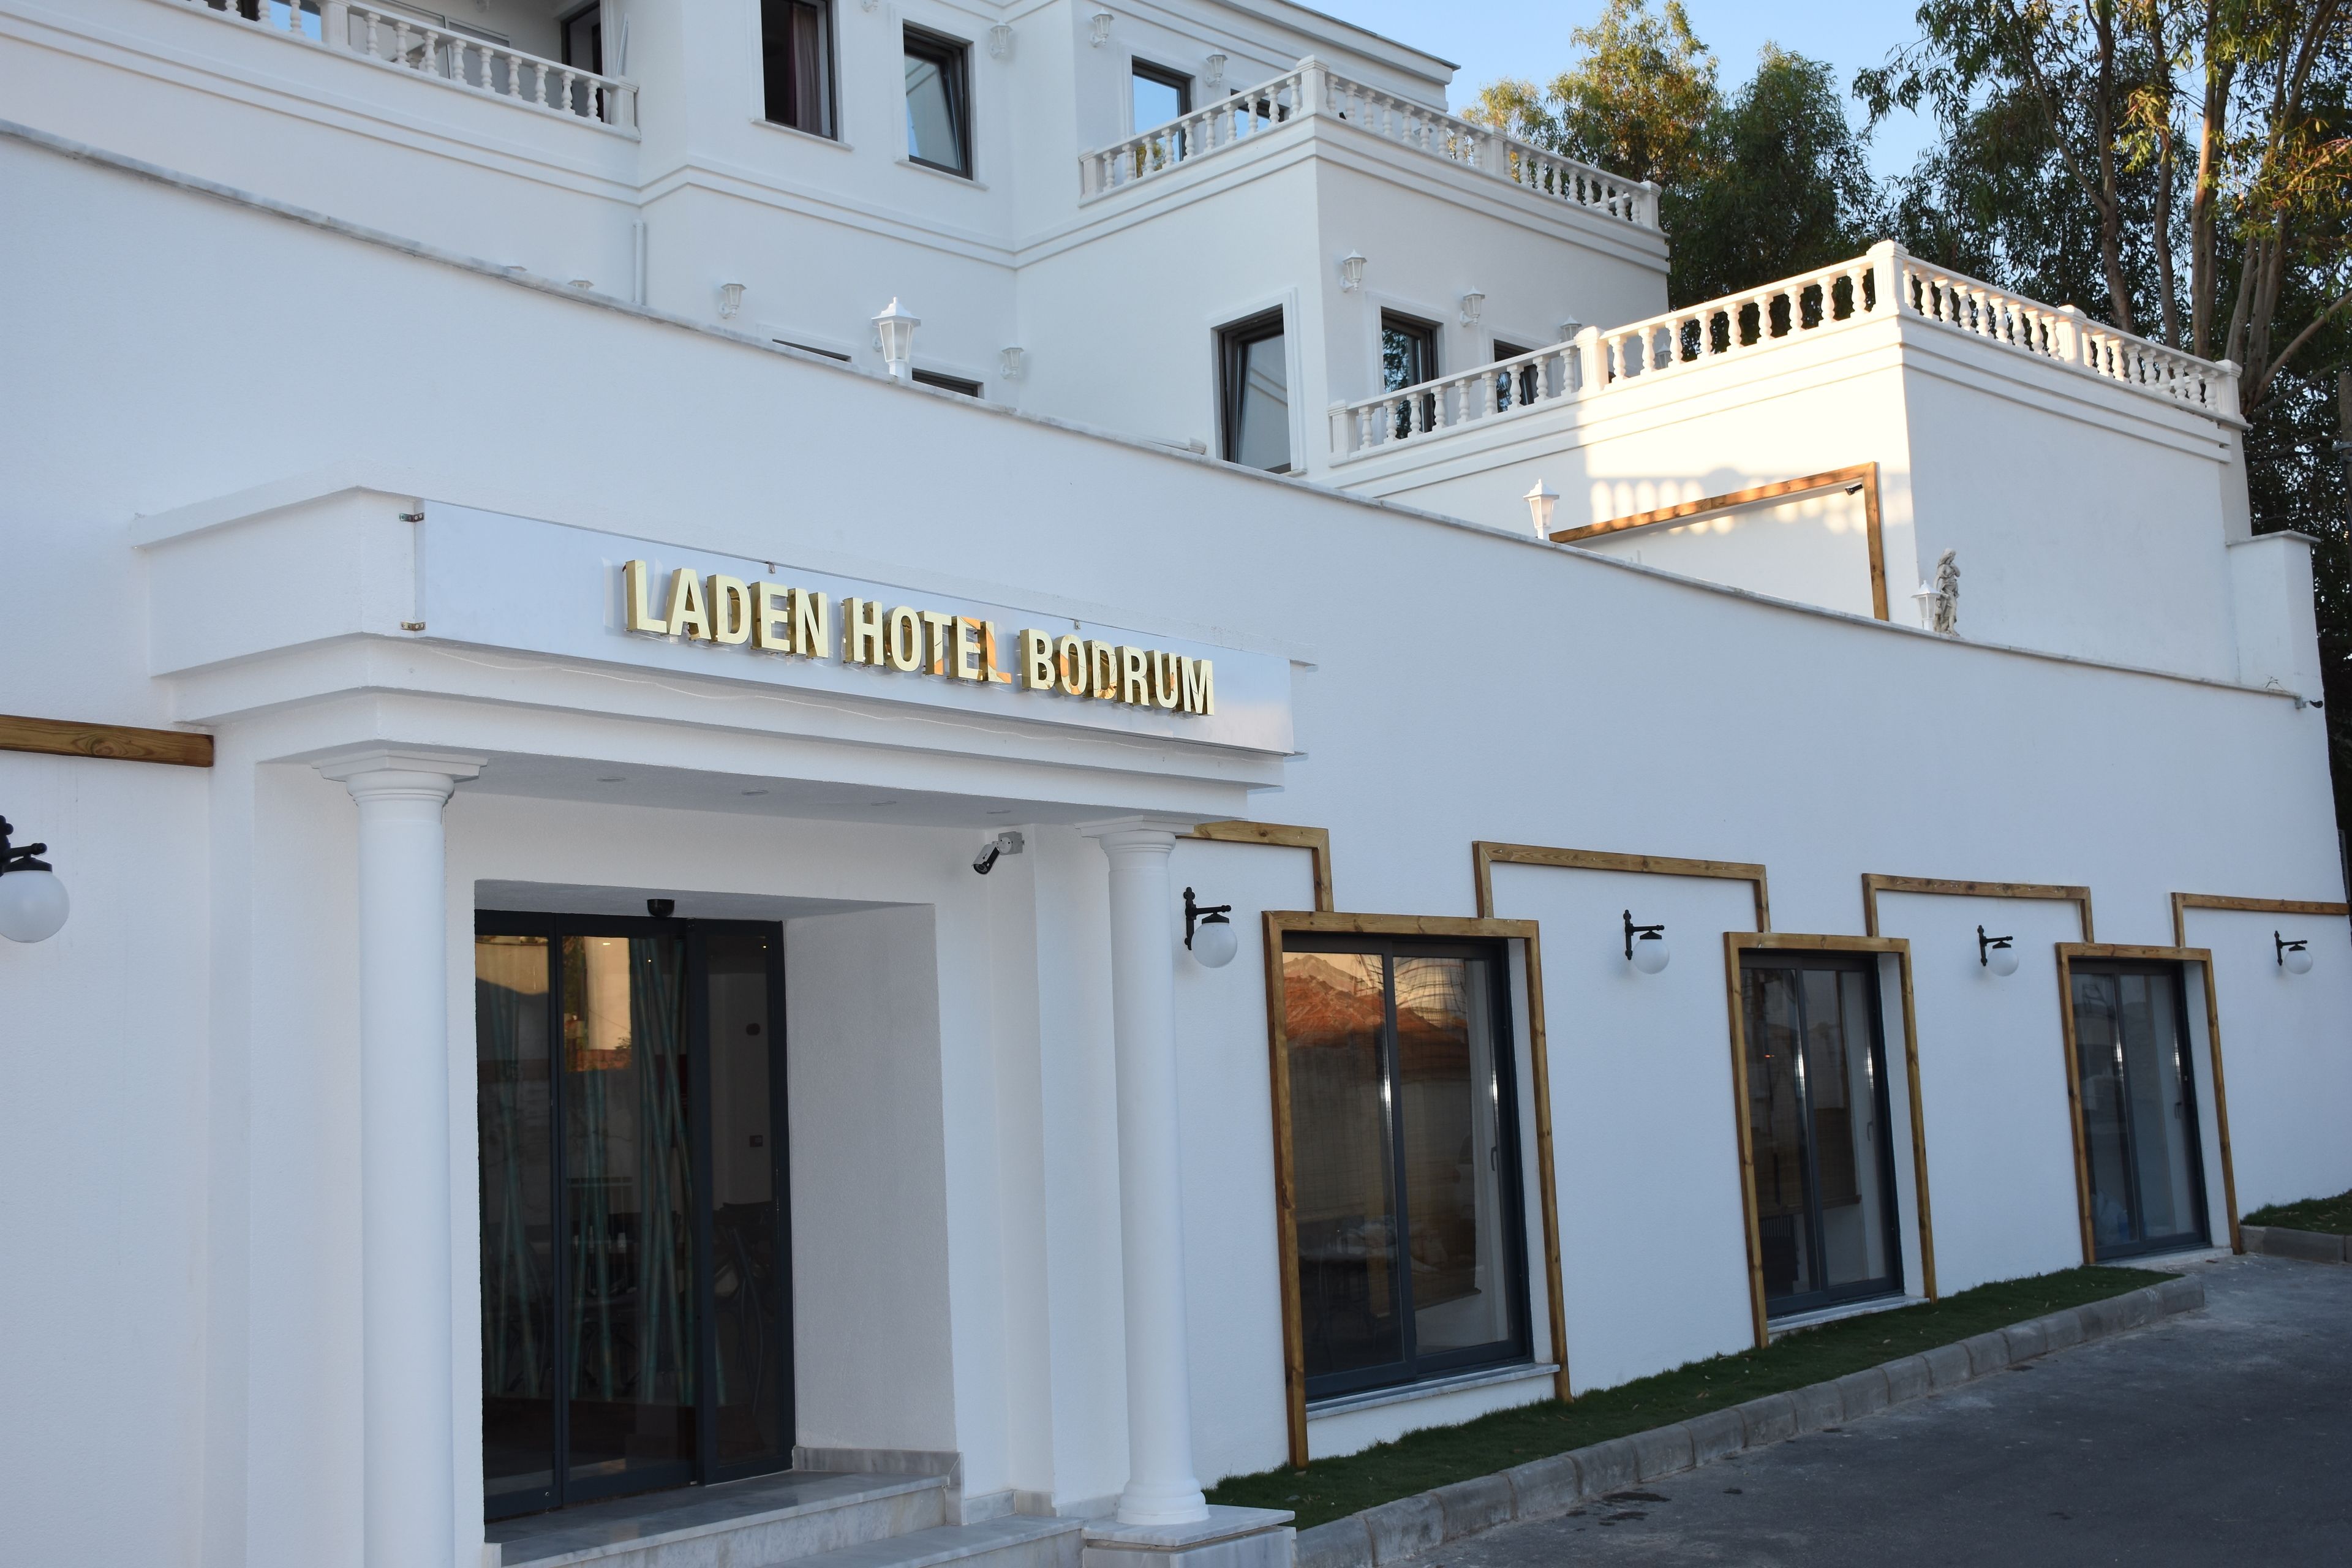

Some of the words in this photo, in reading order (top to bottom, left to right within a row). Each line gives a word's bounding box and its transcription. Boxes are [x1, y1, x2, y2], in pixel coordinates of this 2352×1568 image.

[624, 560, 829, 659] LADEN
[844, 597, 1012, 685] HOTEL
[1019, 628, 1215, 716] BODRUM
